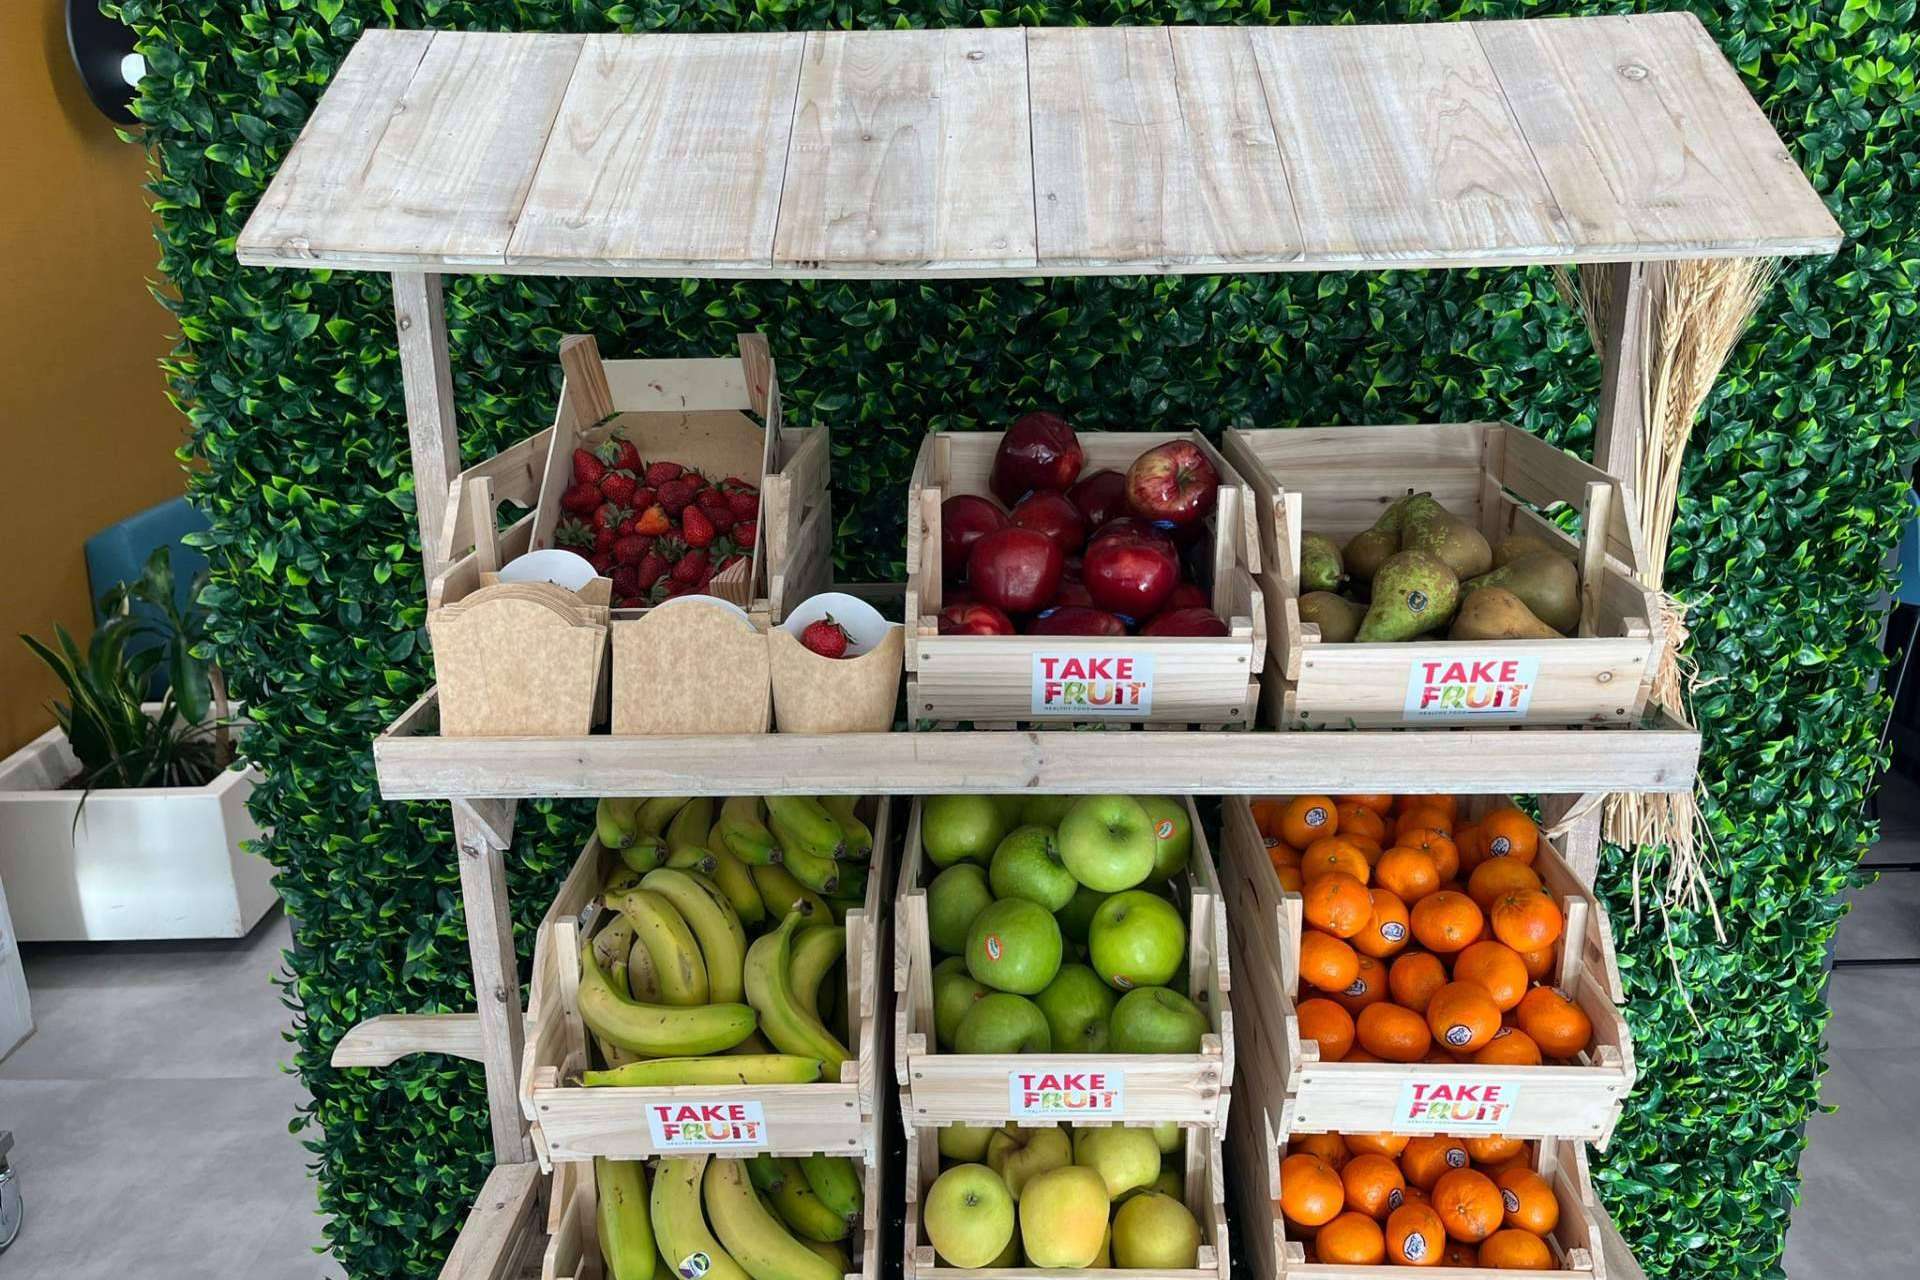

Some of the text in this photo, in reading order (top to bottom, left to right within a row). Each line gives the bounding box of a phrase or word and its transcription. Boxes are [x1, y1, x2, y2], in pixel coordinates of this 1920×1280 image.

[1040, 658, 1133, 680] TAKE
[1422, 660, 1519, 684] TAKE
[1018, 1074, 1105, 1090] TAKE
[1412, 1084, 1501, 1102] TAKE
[653, 1104, 746, 1122] TAKE
